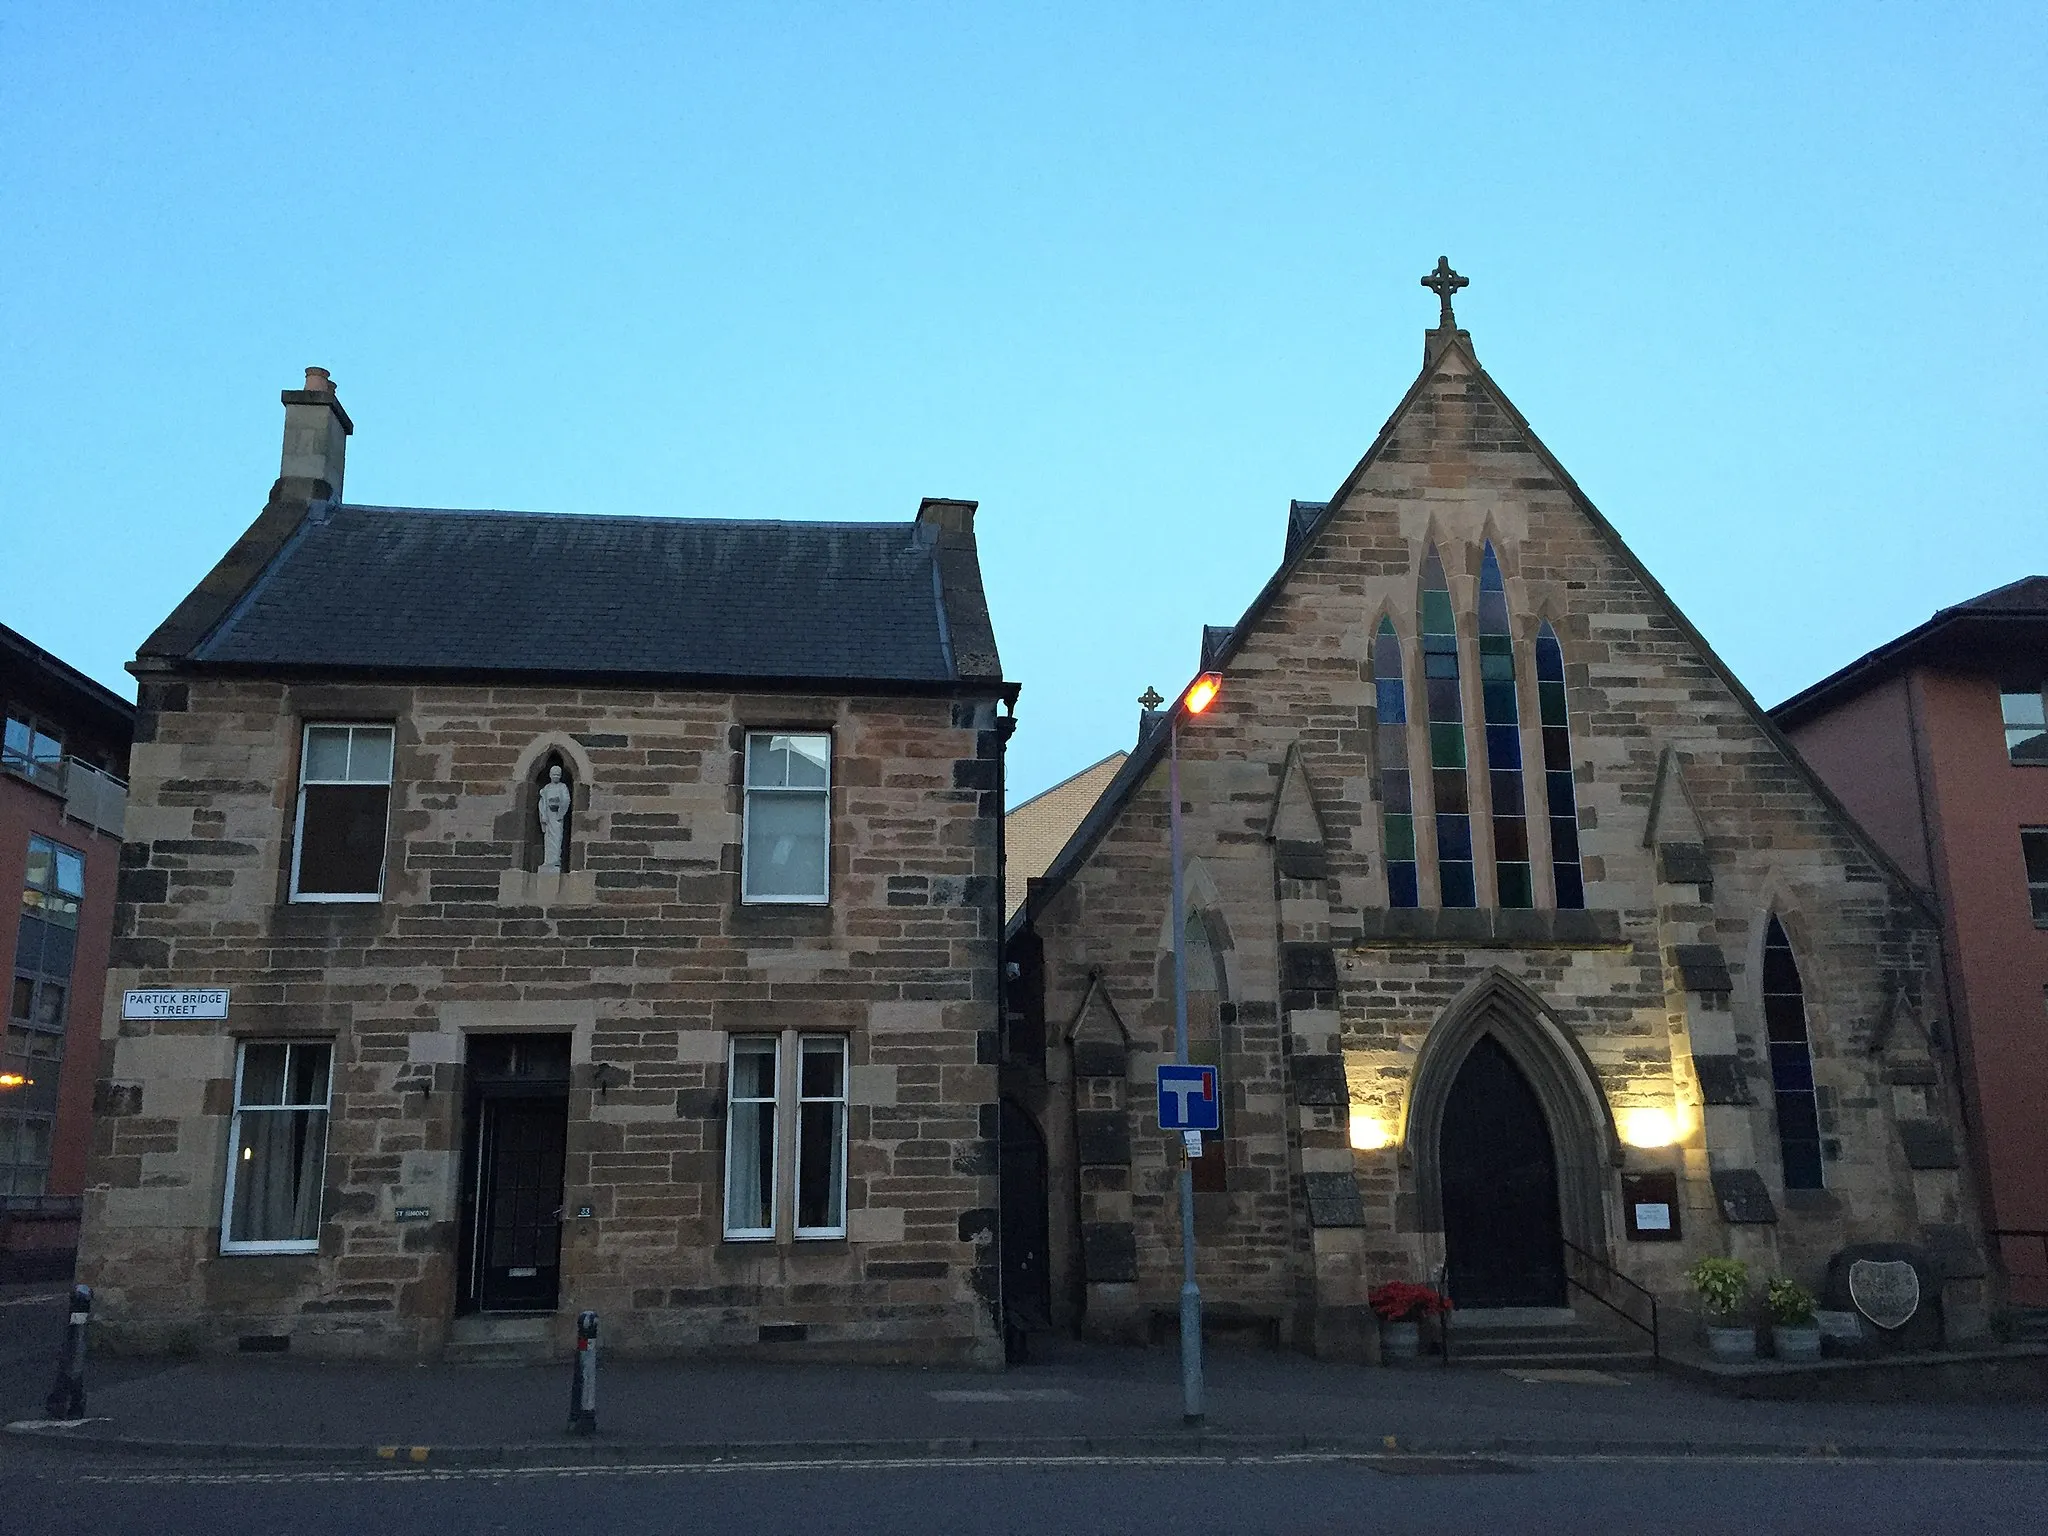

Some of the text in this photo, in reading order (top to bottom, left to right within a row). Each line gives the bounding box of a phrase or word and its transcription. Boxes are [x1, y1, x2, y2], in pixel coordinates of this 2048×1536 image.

[129, 994, 222, 1004] PARTICK BRIDGE
[153, 1005, 197, 1014] STREET
[580, 1207, 590, 1215] 33
